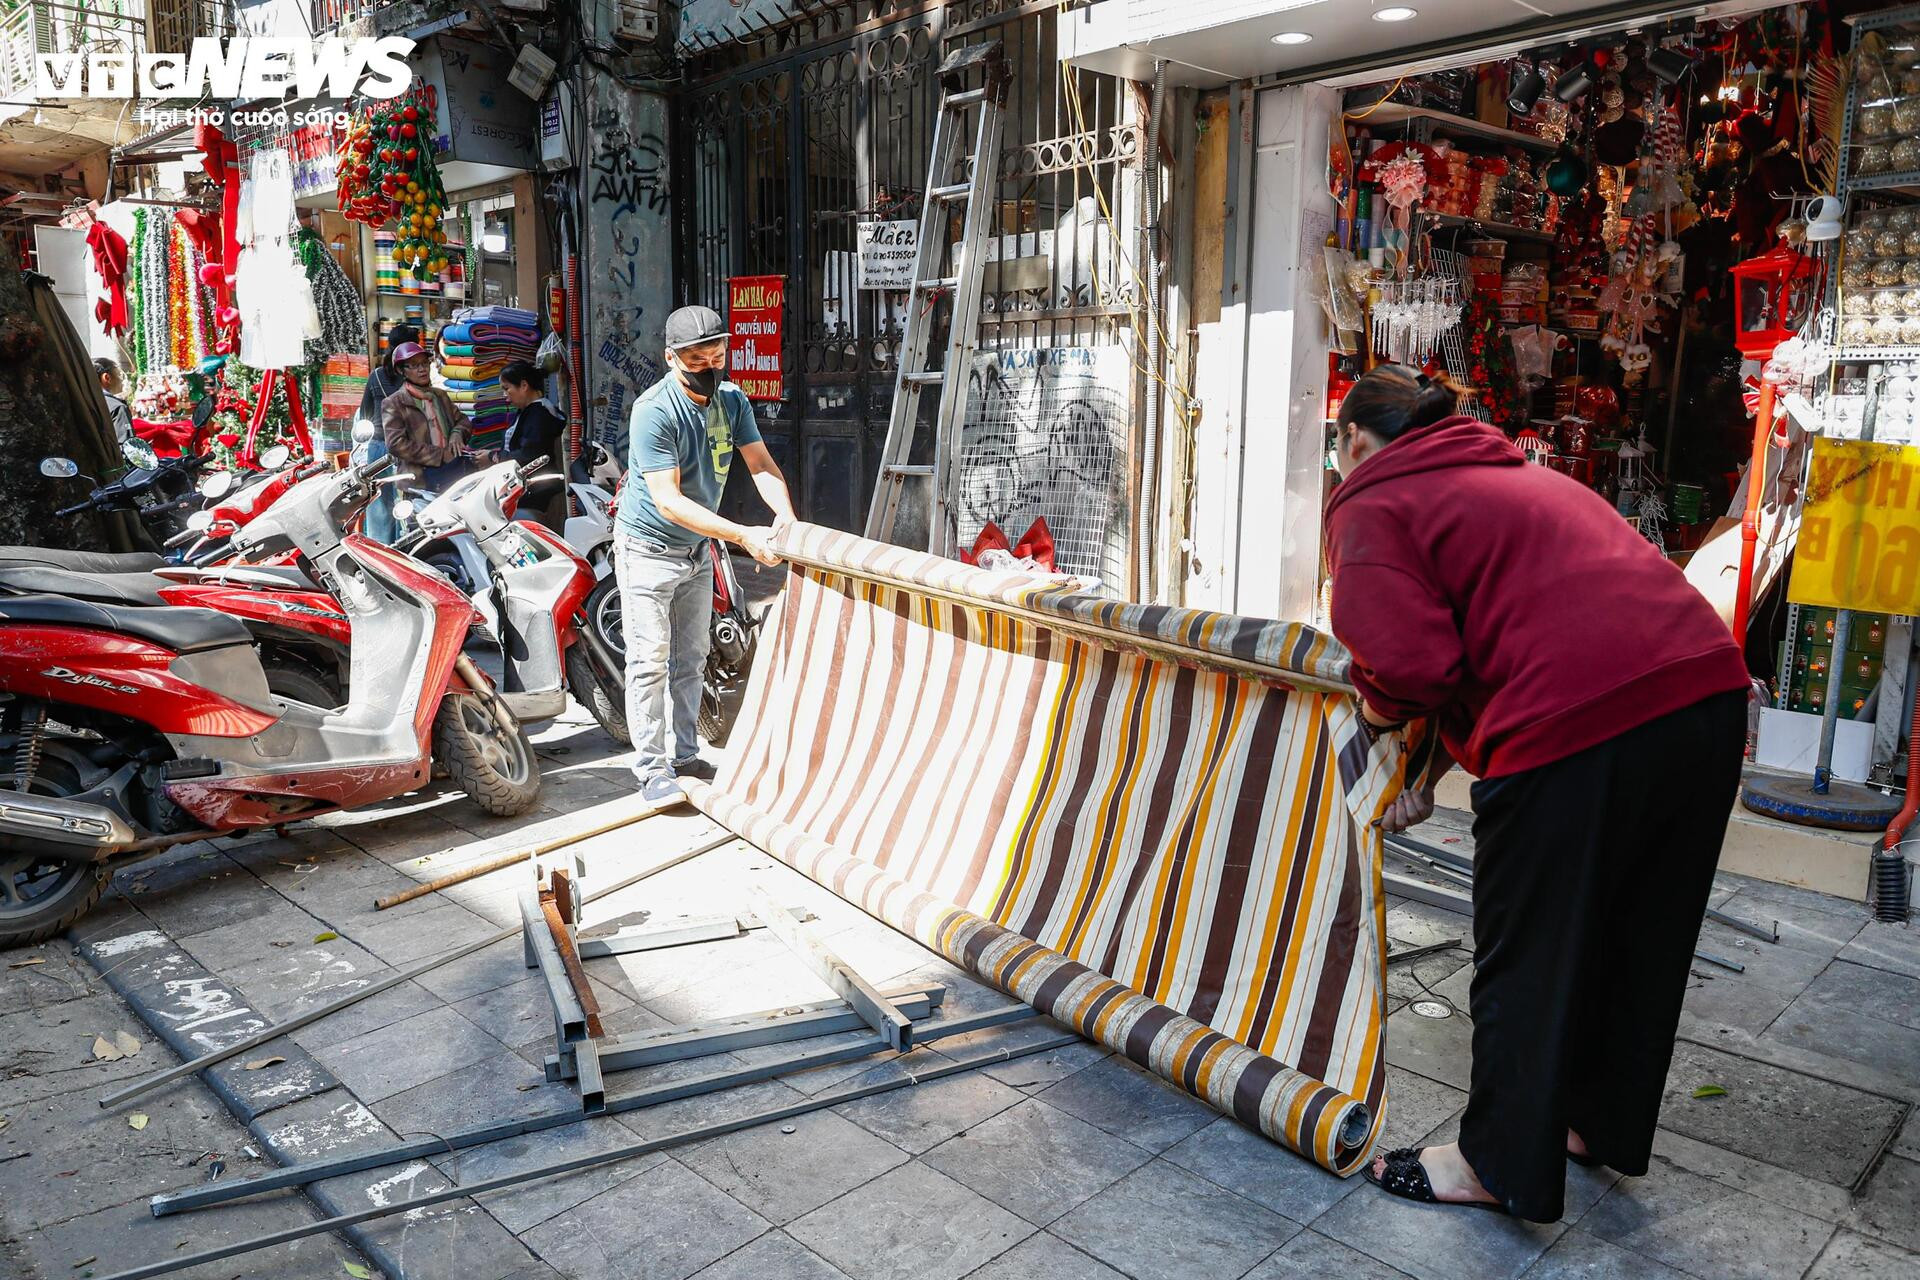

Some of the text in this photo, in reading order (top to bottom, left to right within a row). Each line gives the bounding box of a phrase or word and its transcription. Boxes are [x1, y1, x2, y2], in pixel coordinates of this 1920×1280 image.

[732, 286, 750, 309] LAN
[766, 290, 781, 308] 60
[763, 318, 778, 335] VÀO
[745, 338, 756, 371] 64
[1050, 348, 1067, 366] XE
[757, 379, 768, 397] 716
[769, 380, 780, 398] 181
[40, 665, 116, 689] Dylan
